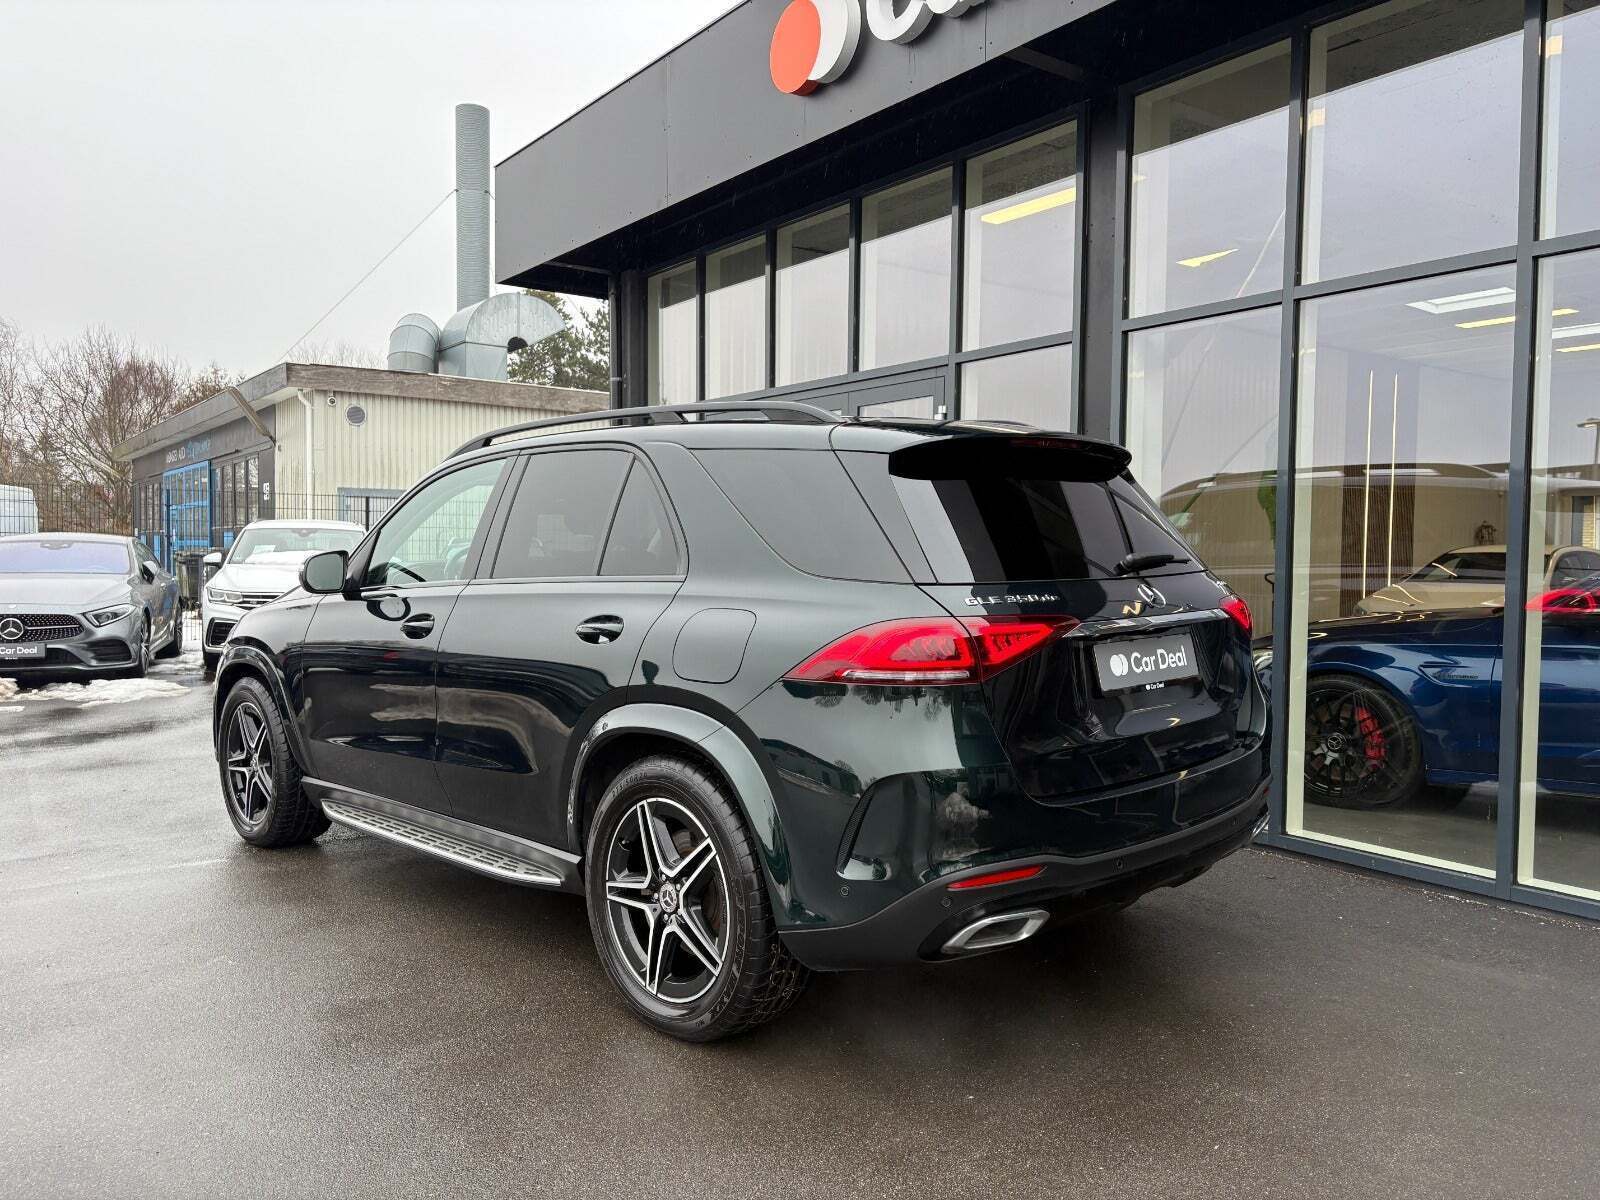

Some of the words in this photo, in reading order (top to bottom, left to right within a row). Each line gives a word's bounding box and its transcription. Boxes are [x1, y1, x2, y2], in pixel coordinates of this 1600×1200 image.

[965, 595, 1004, 606] GLE
[0, 646, 16, 655] Car
[16, 646, 38, 654] Deal
[1131, 651, 1155, 674] Car
[1156, 645, 1188, 670] Deal
